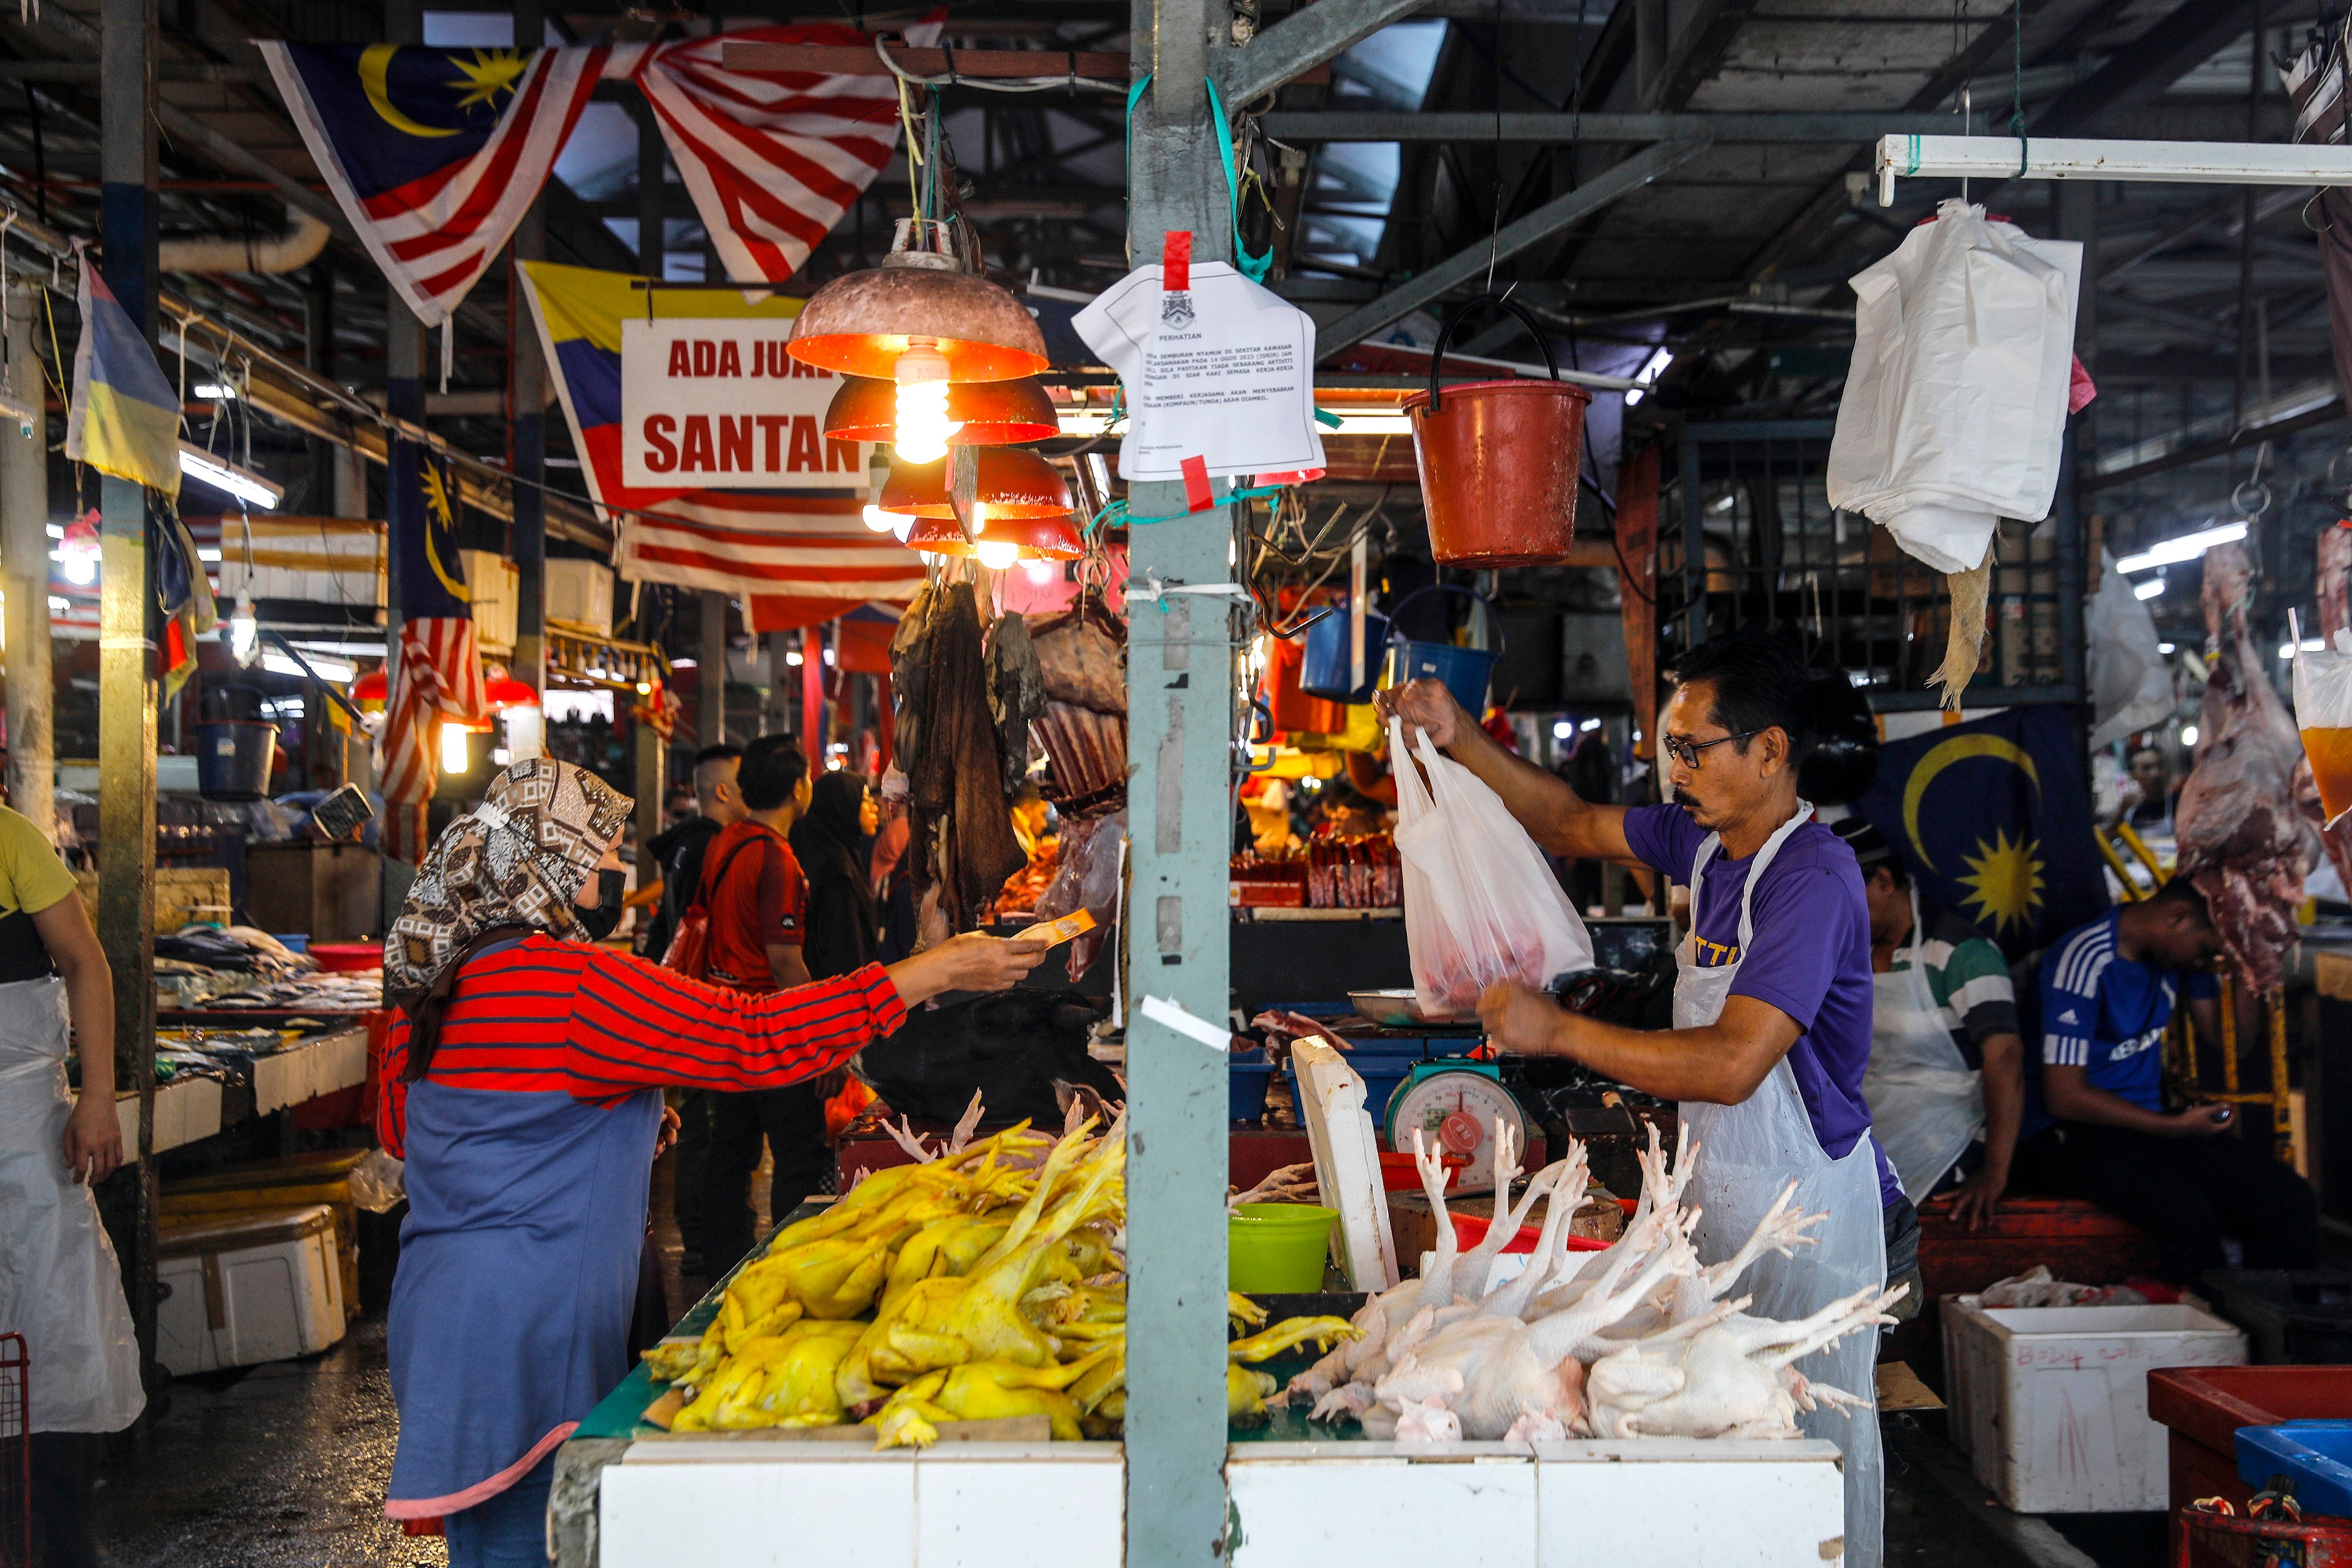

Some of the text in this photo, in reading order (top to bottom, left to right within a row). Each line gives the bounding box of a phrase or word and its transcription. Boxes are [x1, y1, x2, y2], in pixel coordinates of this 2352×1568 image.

[1159, 333, 1202, 341] PERHATIAN
[668, 339, 742, 378] ADA
[1252, 386, 1294, 394] MENYEBABKAN
[643, 414, 860, 473] SANTAN
